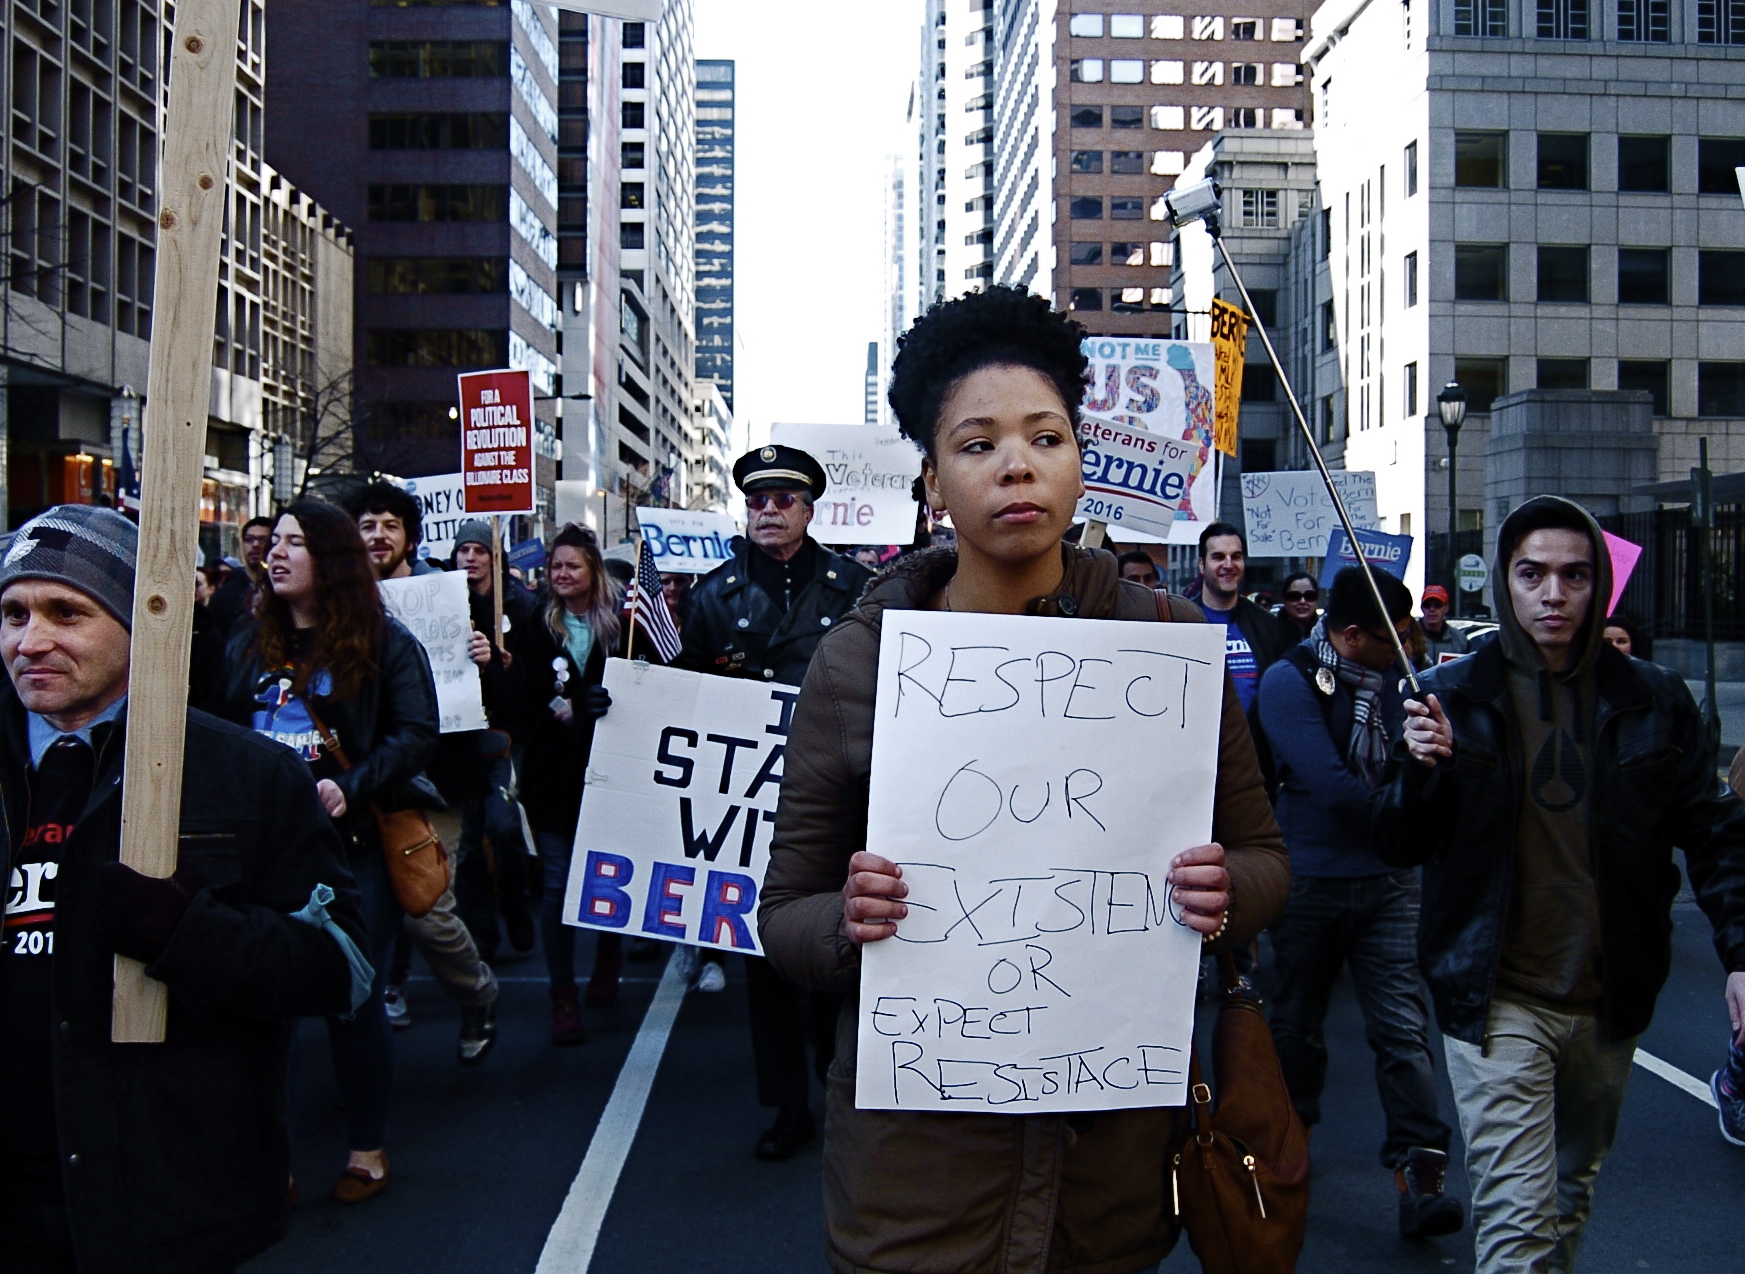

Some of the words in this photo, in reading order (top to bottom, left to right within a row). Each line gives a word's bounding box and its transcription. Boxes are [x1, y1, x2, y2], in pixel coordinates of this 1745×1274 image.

[1081, 341, 1130, 360] NOT
[1135, 343, 1161, 356] ME
[1082, 363, 1161, 414] US
[470, 405, 521, 428] POLITICAL
[466, 427, 526, 450] REVOLUTION
[500, 451, 516, 465] THE
[1081, 422, 1157, 453] eterans
[1162, 441, 1187, 461] for
[502, 468, 529, 484] CLASS
[1081, 449, 1184, 500] ernie
[1351, 474, 1373, 484] The
[1084, 498, 1124, 520] 2016
[1295, 512, 1325, 530] For
[895, 632, 1211, 728] RESPECT
[936, 759, 1105, 840] OUR
[578, 850, 757, 950] BER
[987, 944, 1071, 997] OR
[872, 997, 1047, 1039] EXPECT
[892, 1041, 1182, 1104] RESISTACE
